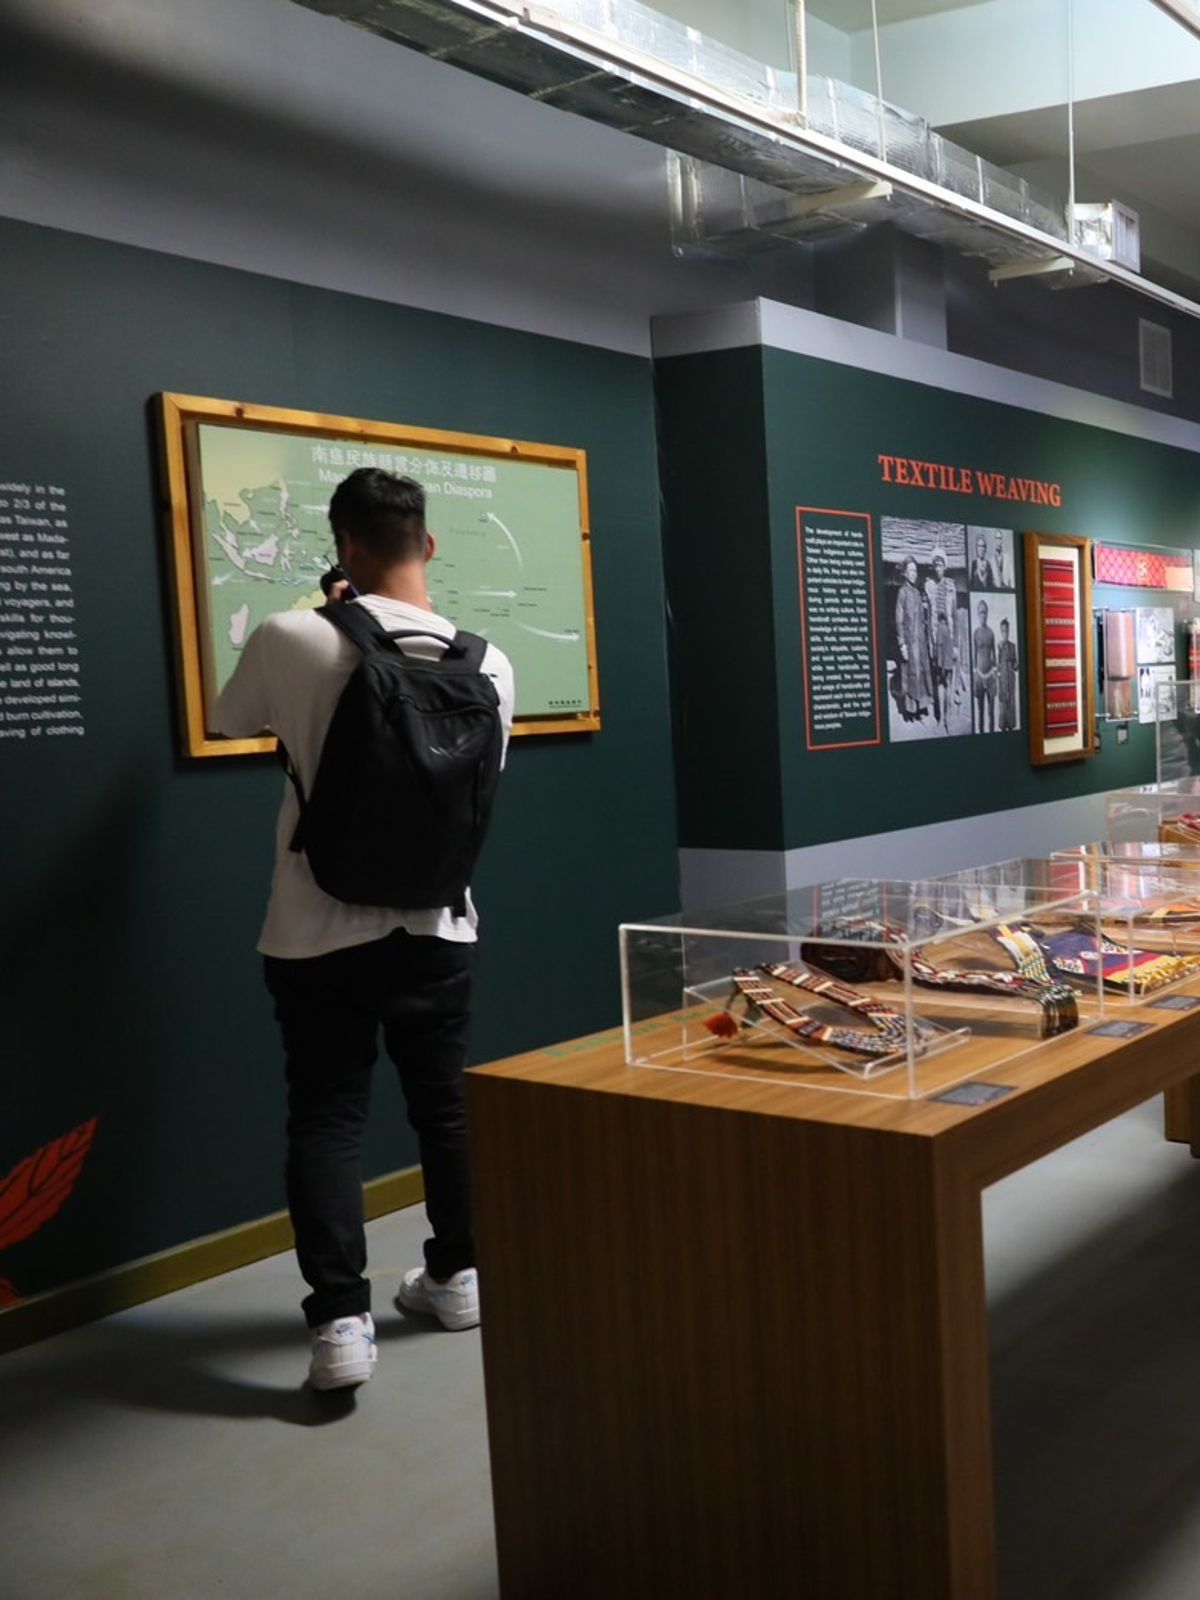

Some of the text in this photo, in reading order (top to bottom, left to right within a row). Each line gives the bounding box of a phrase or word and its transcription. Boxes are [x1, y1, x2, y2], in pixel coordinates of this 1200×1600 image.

[877, 454, 1062, 507] TEXTILE WEAVING
[48, 486, 65, 496] the
[443, 481, 493, 500] Diaspora
[34, 500, 46, 511] of
[49, 502, 67, 512] the
[14, 514, 53, 527] Taiwan,
[19, 549, 39, 559] and
[31, 564, 72, 576] America
[13, 580, 28, 592] by
[30, 581, 48, 591] the
[54, 598, 74, 608] and
[29, 613, 45, 623] for
[0, 630, 40, 642] vigating
[7, 646, 78, 656] allow them to
[14, 664, 27, 672] as
[29, 662, 55, 673] good
[57, 662, 80, 673] long
[34, 677, 45, 687] of
[4, 694, 57, 705] developed
[6, 712, 30, 721] burn
[0, 726, 85, 739] aving of clothing
